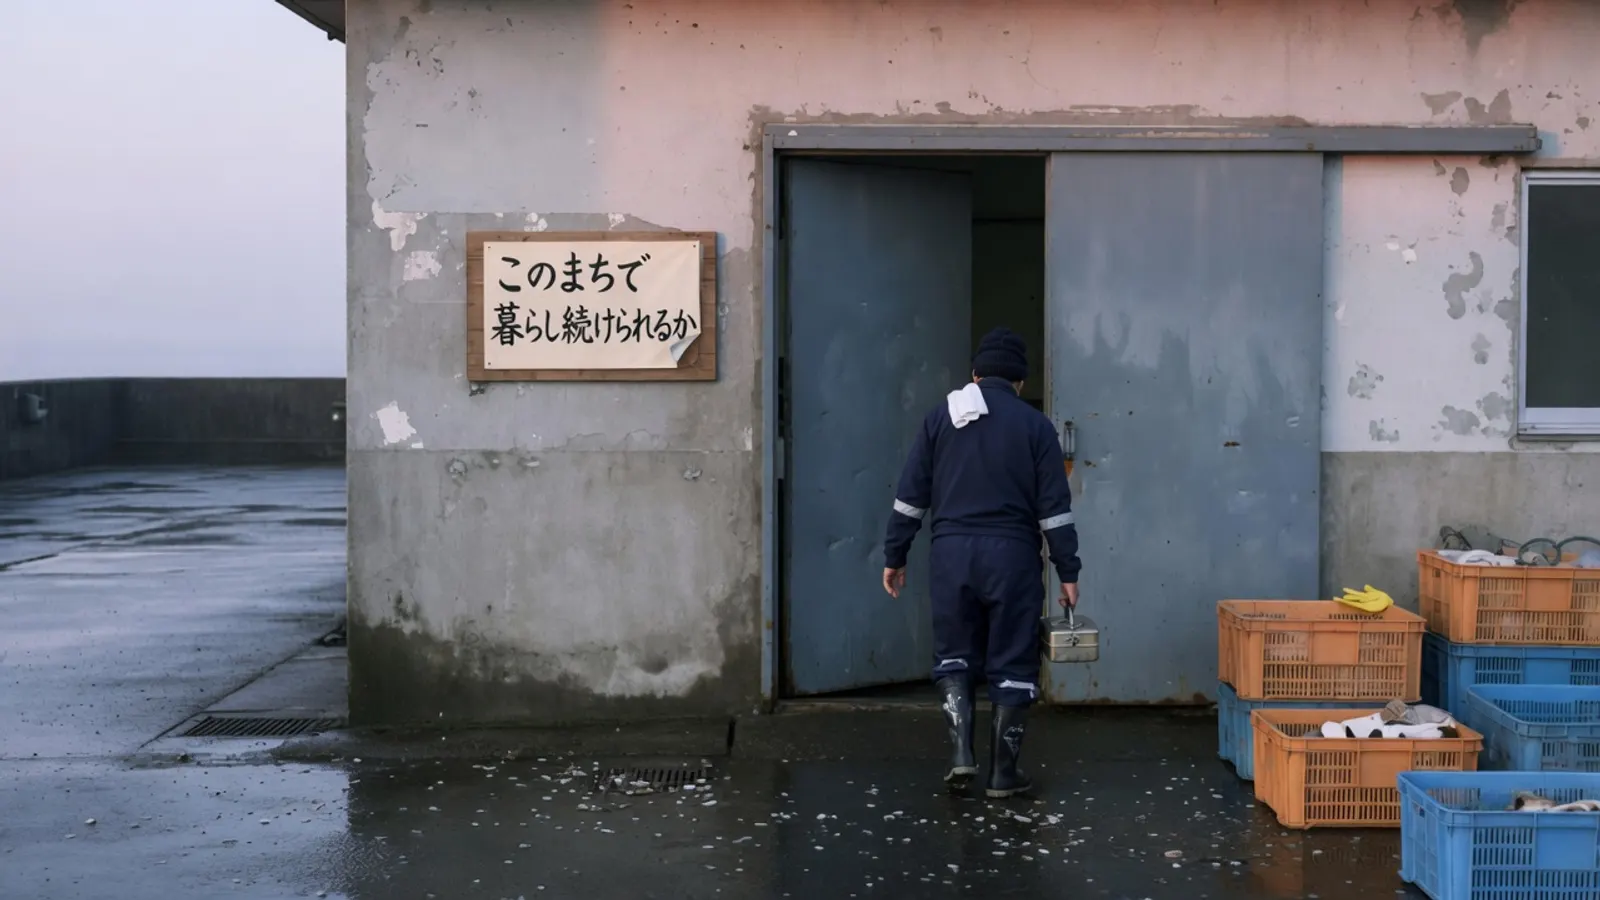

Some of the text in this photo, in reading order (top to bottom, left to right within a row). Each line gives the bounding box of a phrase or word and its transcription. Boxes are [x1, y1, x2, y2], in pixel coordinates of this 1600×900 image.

[498, 252, 651, 292] このまちで
[491, 302, 697, 346] 暮らし続けられるか
